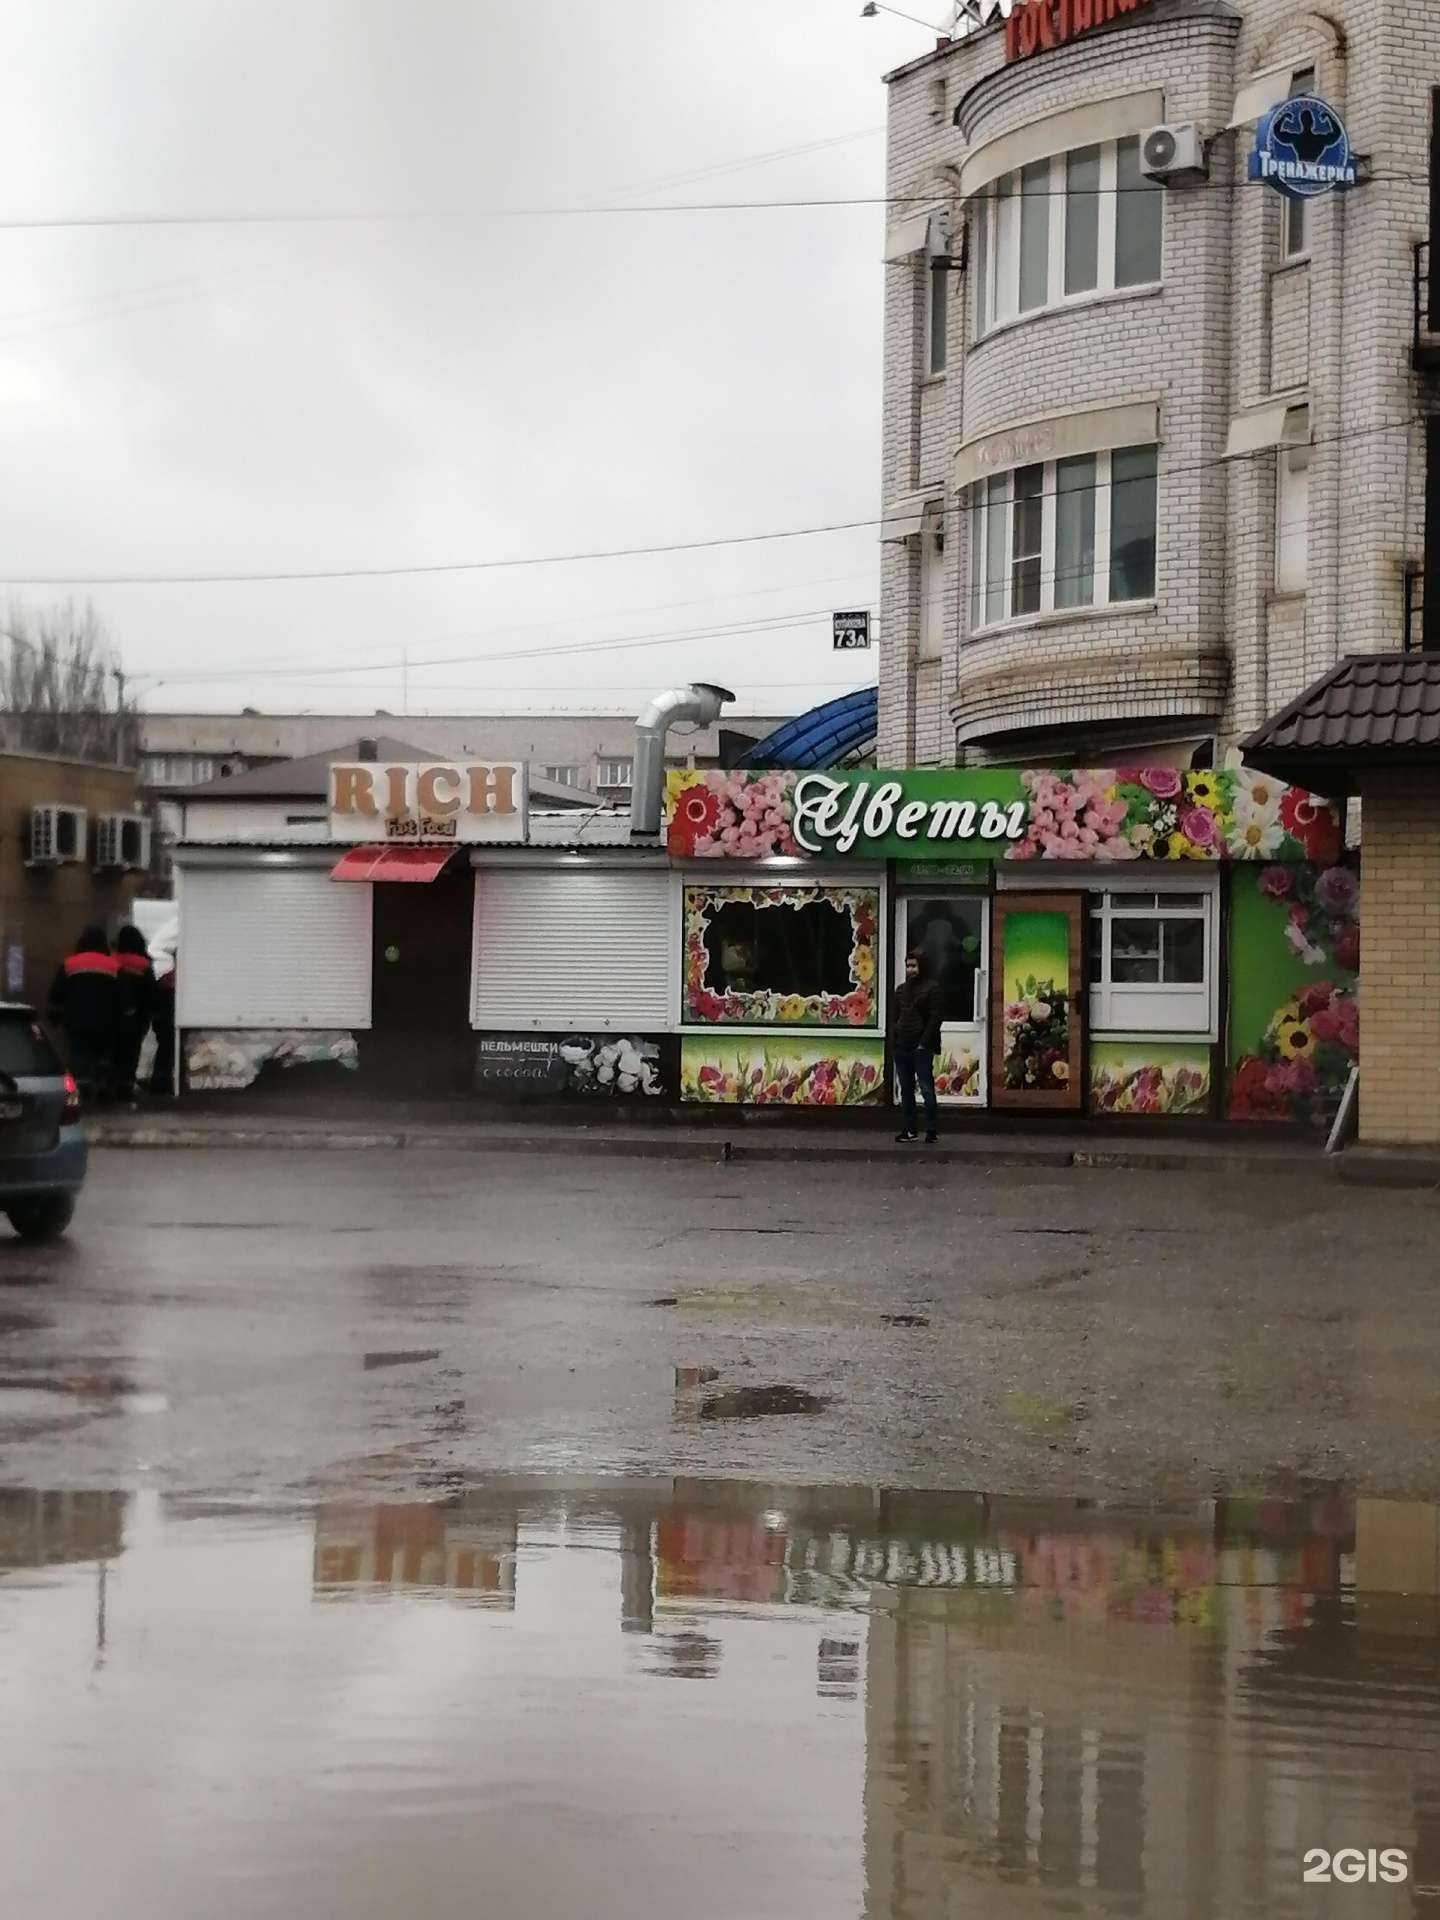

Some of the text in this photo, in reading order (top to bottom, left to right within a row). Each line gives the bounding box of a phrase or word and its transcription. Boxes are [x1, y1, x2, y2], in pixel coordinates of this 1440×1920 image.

[332, 766, 518, 816] RICH
[793, 774, 1026, 853] Цветы
[418, 817, 457, 836] Food
